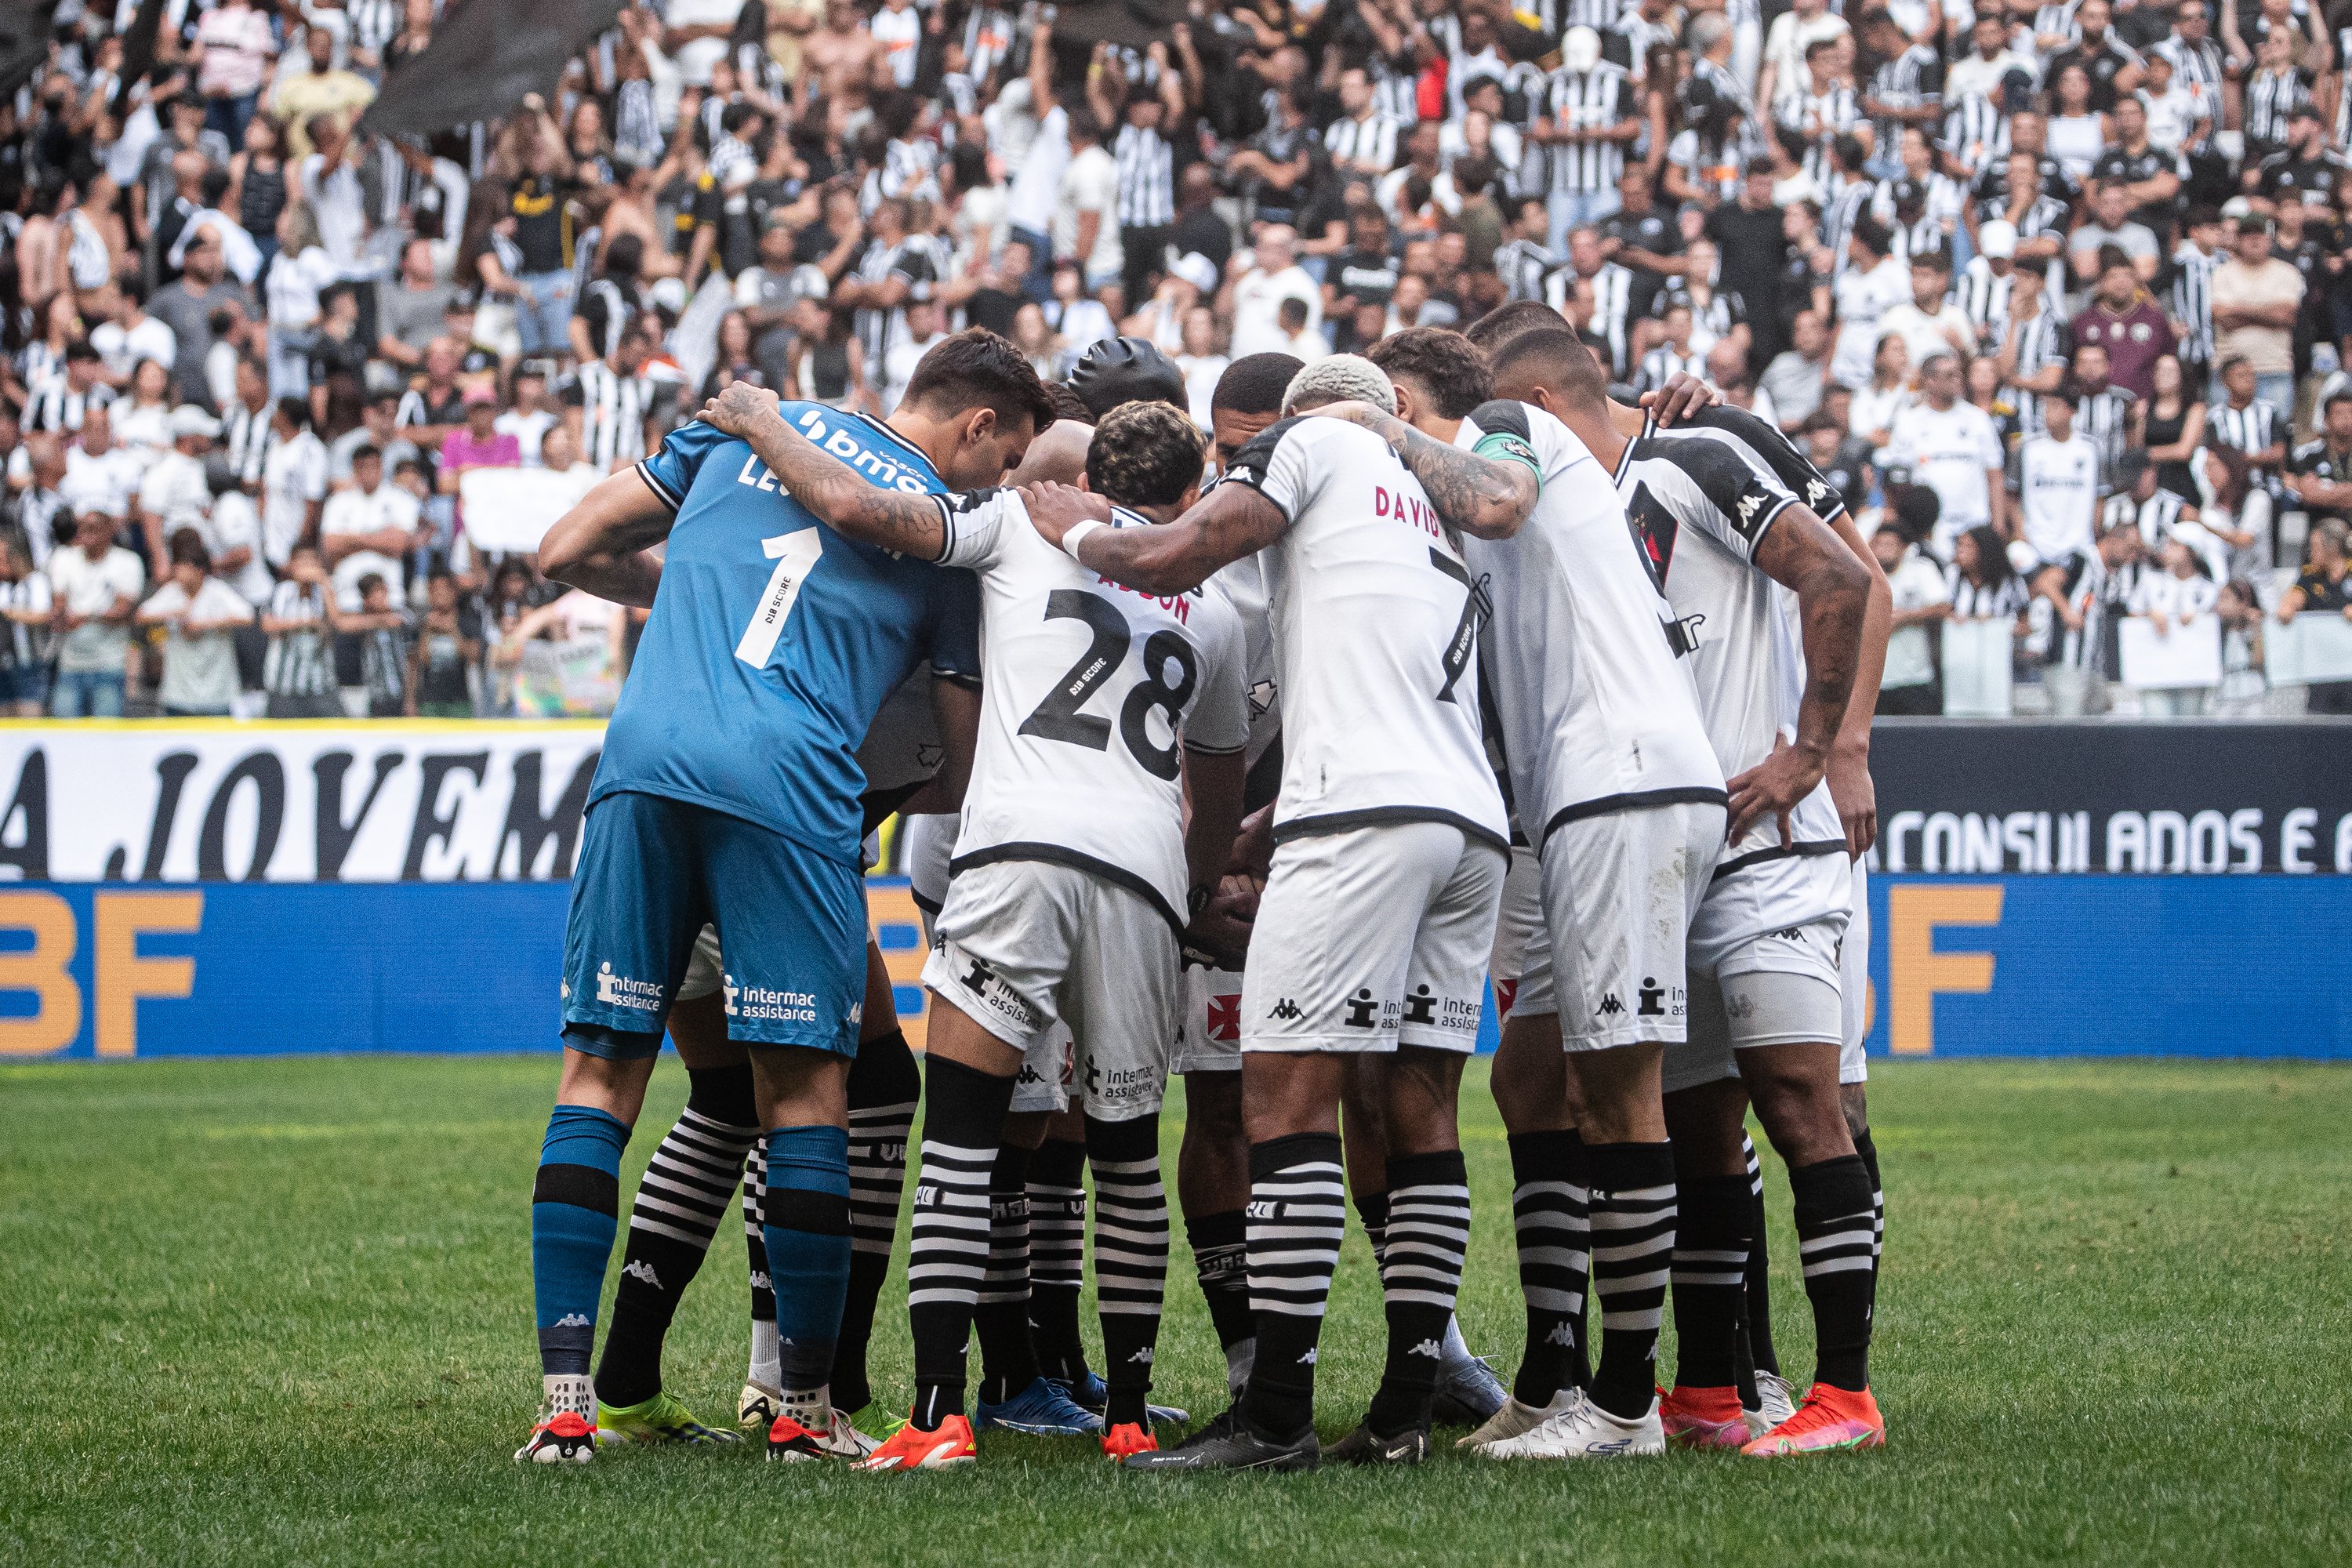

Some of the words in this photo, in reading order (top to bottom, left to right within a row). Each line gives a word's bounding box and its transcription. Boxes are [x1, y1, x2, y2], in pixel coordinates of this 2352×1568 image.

[1375, 485, 1439, 538] DAVID
[735, 525, 823, 670] 1
[772, 575, 792, 608] SCORE
[1016, 588, 1198, 782] 28
[1081, 657, 1107, 682] SCORE
[2280, 808, 2318, 873] E
[742, 986, 816, 1007] intermac
[742, 1004, 816, 1022] assistance
